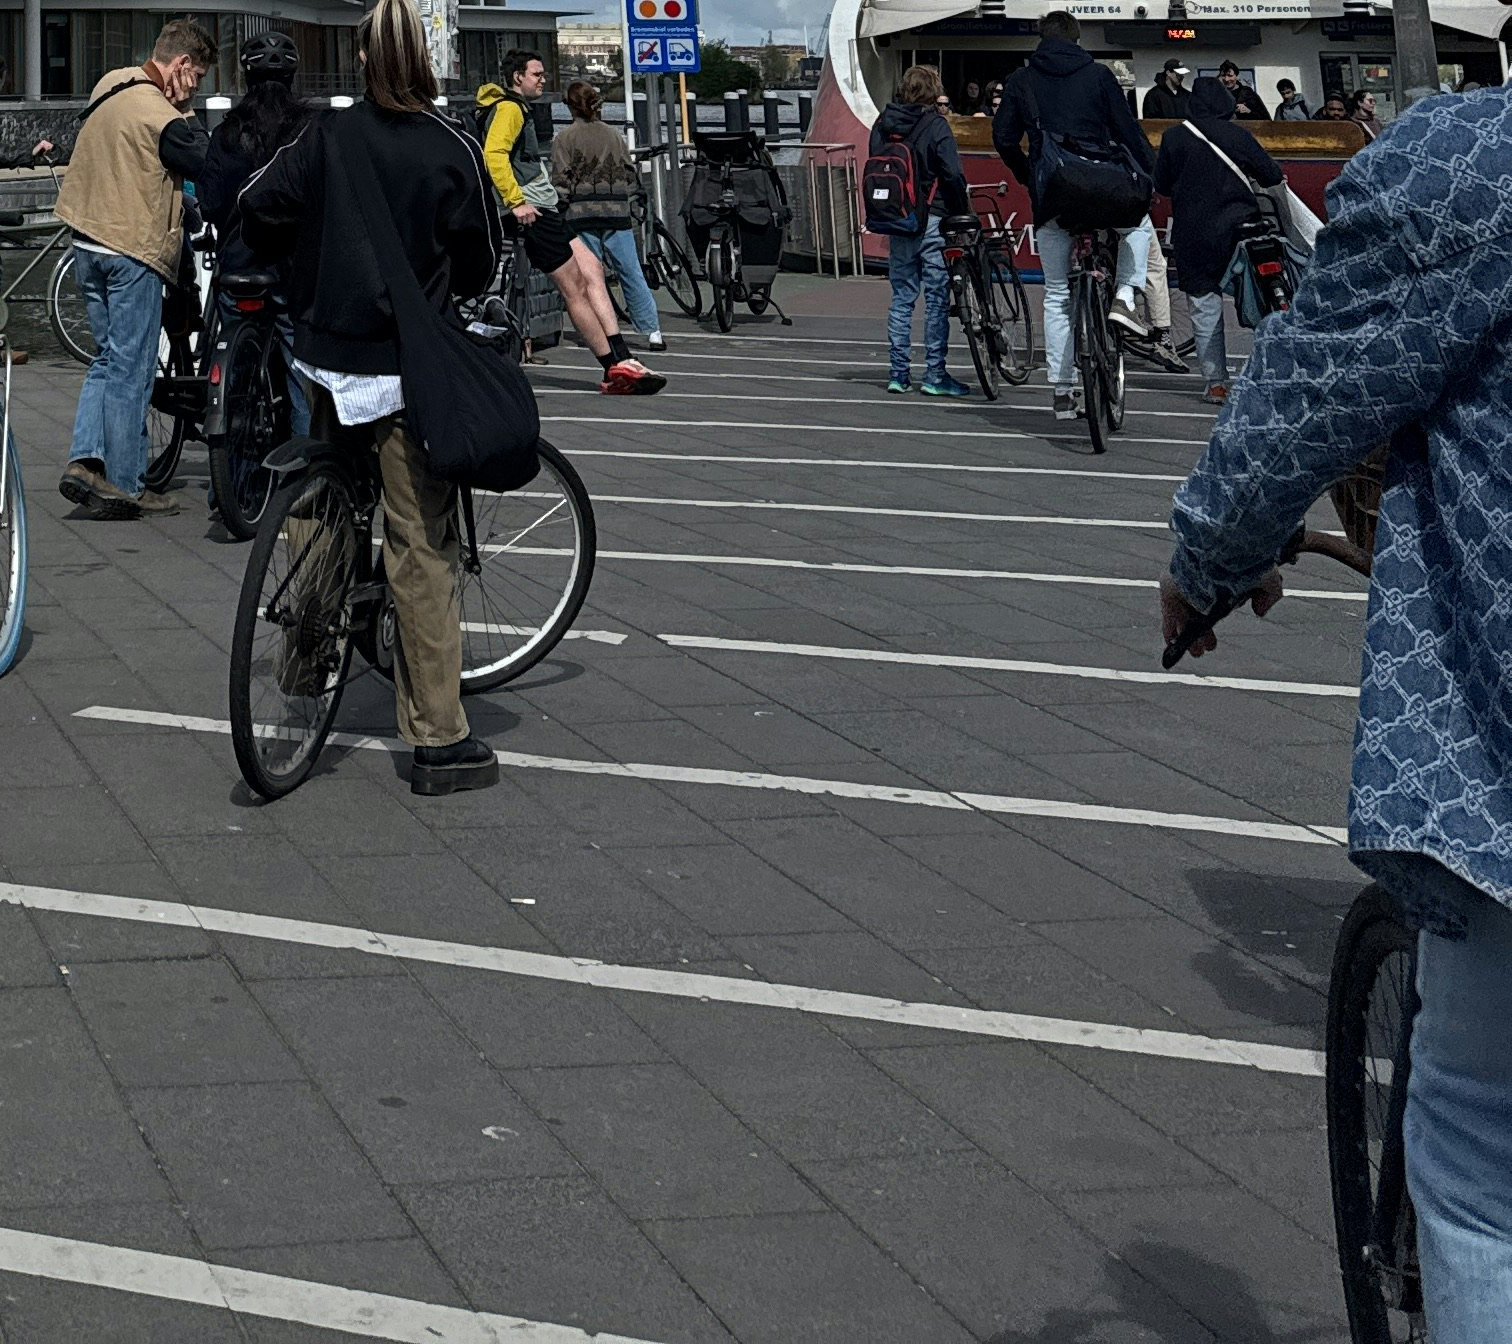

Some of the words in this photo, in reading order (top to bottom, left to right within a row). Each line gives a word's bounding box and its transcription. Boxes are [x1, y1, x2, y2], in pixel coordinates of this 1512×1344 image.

[1107, 5, 1122, 14] 64
[1232, 4, 1254, 13] 310
[1256, 4, 1311, 14] Personen
